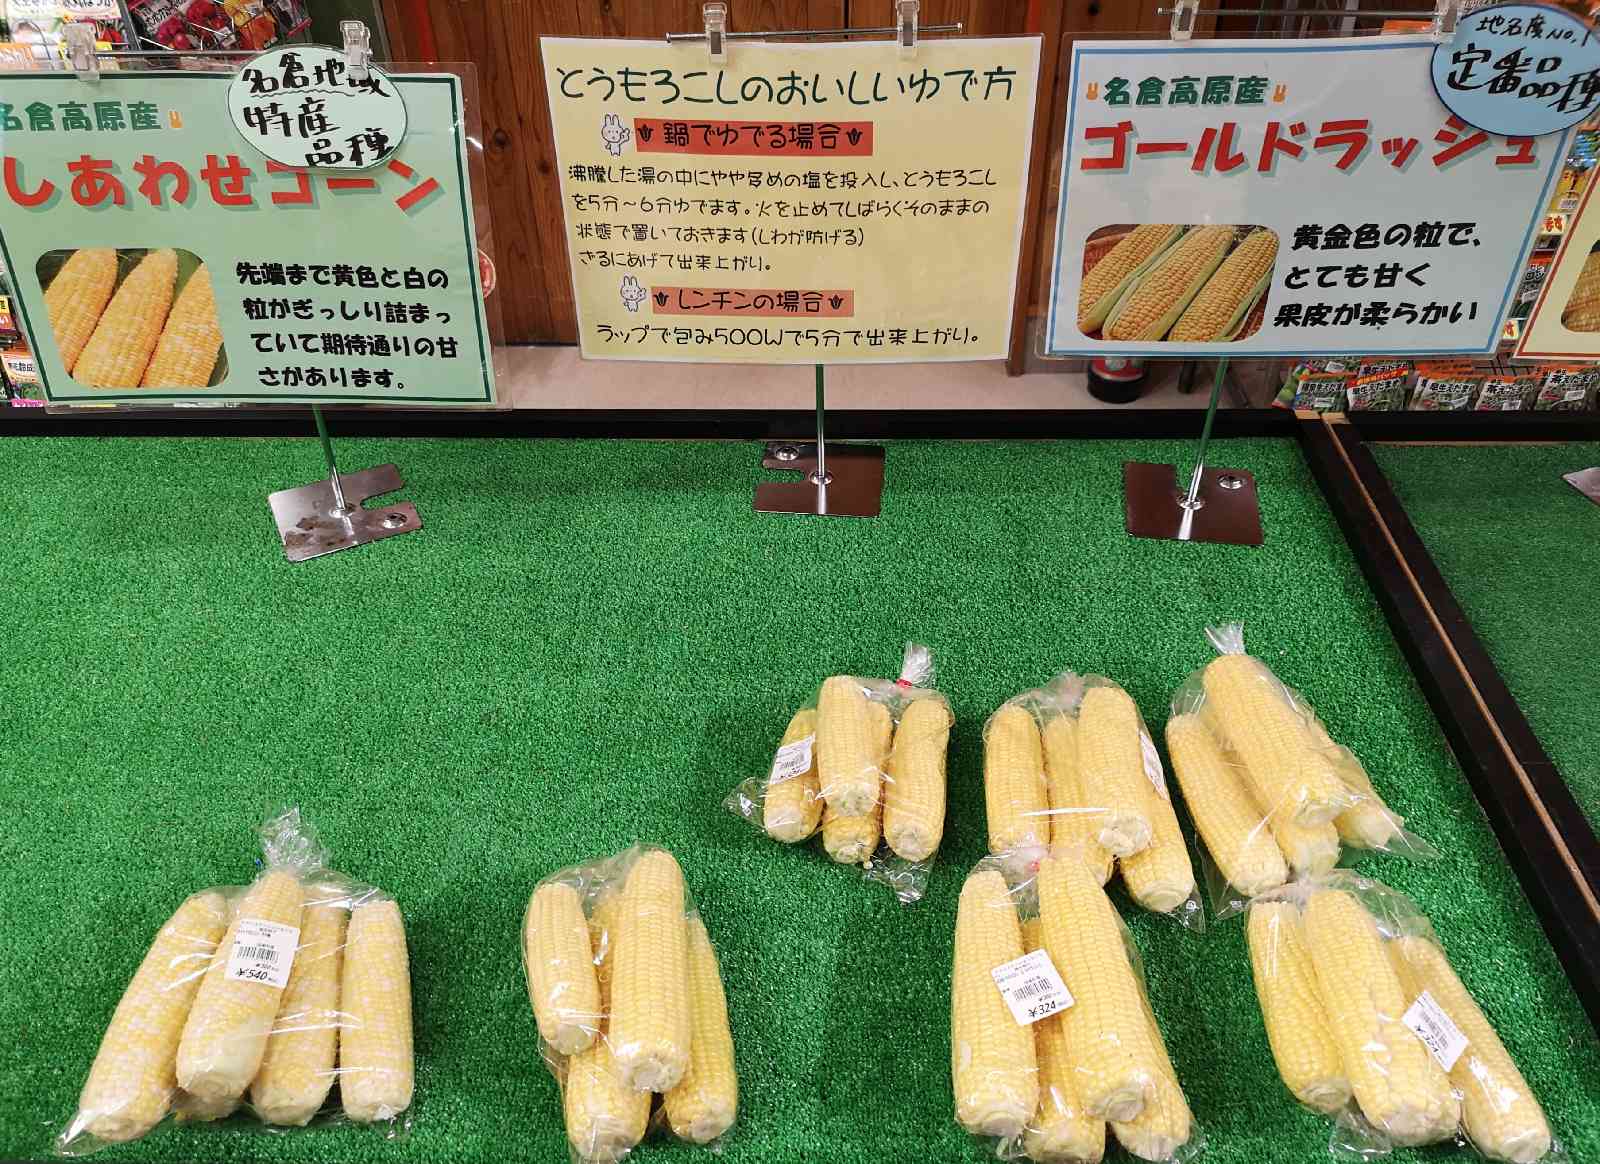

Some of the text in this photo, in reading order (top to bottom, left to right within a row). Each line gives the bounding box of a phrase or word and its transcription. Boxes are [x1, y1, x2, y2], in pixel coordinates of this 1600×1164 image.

[556, 66, 1017, 105] とうもろこしのおいしいゆで方
[1103, 76, 1269, 106] 名倉高原産
[0, 101, 162, 132] 名倉高原産
[243, 97, 341, 138] 特産
[663, 123, 841, 151] 鍋でゆでる場合
[1080, 114, 1537, 172] ゴールドラッシュ
[3, 154, 439, 213] しあわせコーン
[1291, 221, 1481, 251] 黄金色の粒で、
[236, 261, 449, 290] 先端まで黄色と白の
[1284, 262, 1431, 290] とても甘く
[243, 297, 451, 325] 粒がぎっしり詰まっ
[677, 290, 822, 313] レンチンの場合
[1273, 301, 1478, 328] 果皮が柔らかい
[250, 332, 458, 359] ていて期待通りの甘
[258, 366, 405, 391] さがあります。
